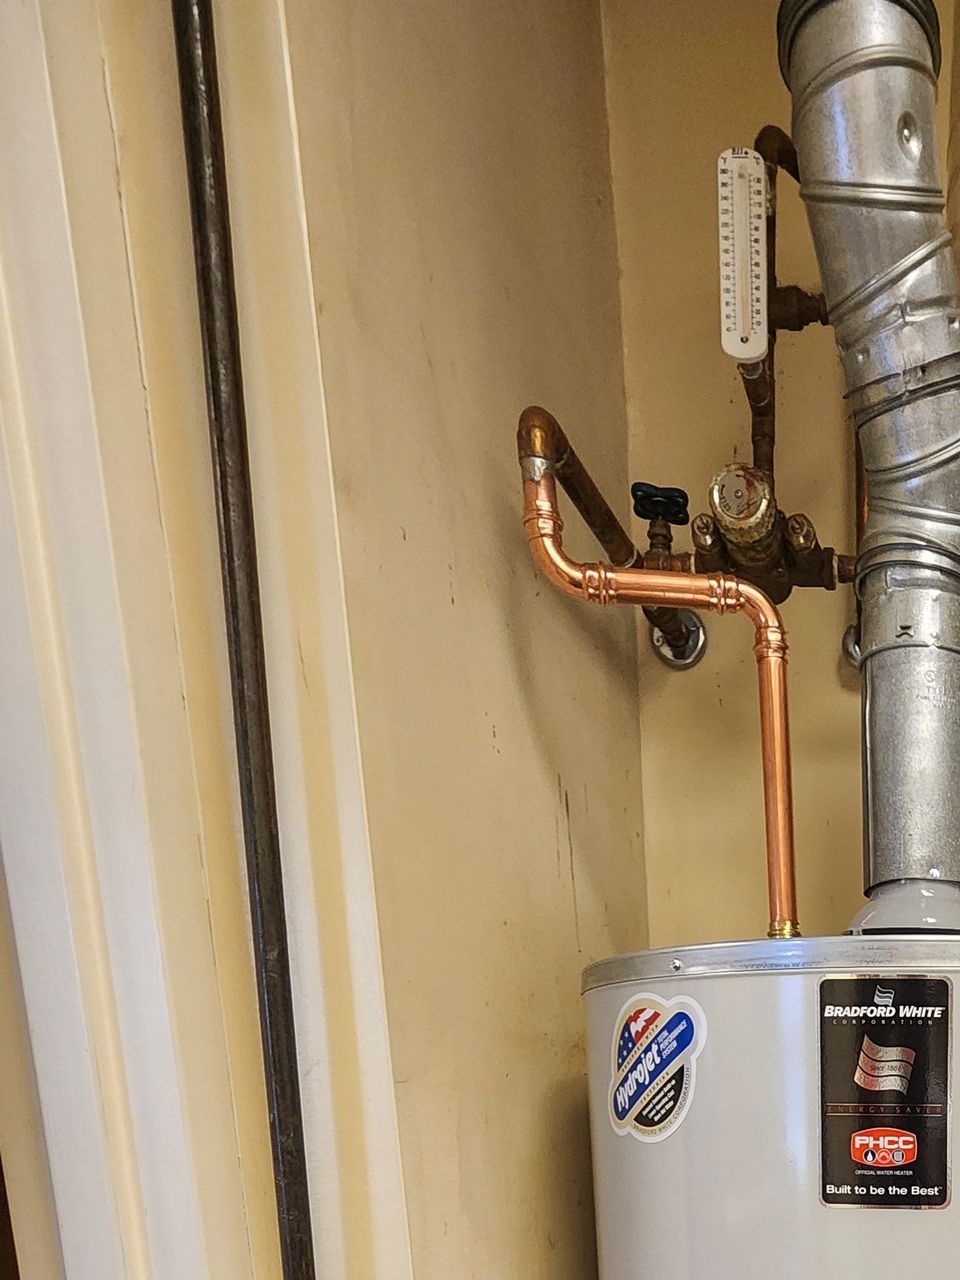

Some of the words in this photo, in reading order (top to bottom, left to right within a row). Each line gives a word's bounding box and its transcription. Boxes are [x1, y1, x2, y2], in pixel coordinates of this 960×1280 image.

[824, 1004, 896, 1017] BRADFORD
[616, 1040, 662, 1112] Hydrojet
[640, 1070, 670, 1104] FEATURING
[672, 1066, 692, 1120] CORPORATION
[854, 1136, 914, 1150] PHCC
[826, 1184, 852, 1194] Built
[854, 1186, 866, 1195] to
[870, 1186, 886, 1195] be
[888, 1186, 908, 1196] the
